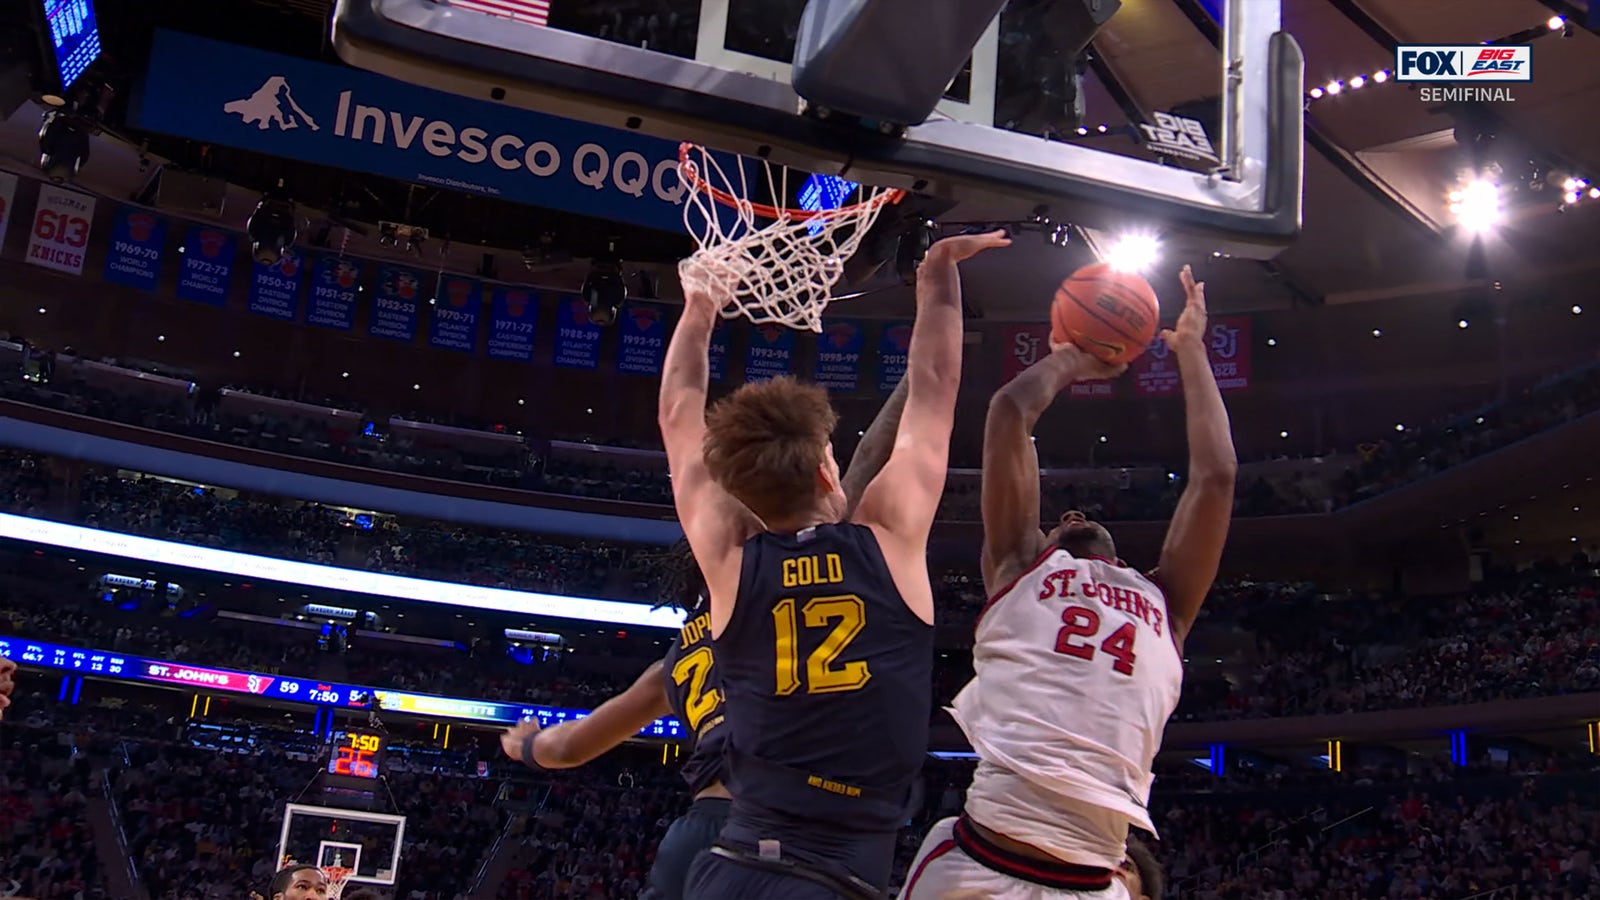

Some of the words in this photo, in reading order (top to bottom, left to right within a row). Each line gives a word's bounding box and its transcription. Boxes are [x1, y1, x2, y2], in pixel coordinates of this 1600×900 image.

[334, 90, 560, 177] Invesco
[573, 143, 690, 206] QQQ
[34, 208, 89, 248] 613
[30, 244, 82, 268] KNICKS
[115, 241, 158, 260] 1969-70
[110, 262, 154, 278] CHAMPIONS
[120, 256, 148, 268] WORLD
[186, 258, 228, 276] 1972-73
[190, 272, 218, 284] WORLD
[257, 274, 296, 291] 1950-51
[182, 280, 224, 294] CHAMPIONS
[316, 286, 354, 302] 1951-52
[377, 298, 416, 313] 1952-53
[437, 308, 474, 324] 1970-71
[495, 319, 534, 334] 1971-72
[782, 554, 844, 588] GOLD
[1039, 569, 1078, 600] ST.
[1081, 576, 1163, 638] JOHN'S
[772, 594, 872, 696] 12
[1054, 606, 1136, 676] 24
[54, 657, 64, 666] 11
[109, 665, 122, 674] 30
[148, 664, 170, 677] ST.
[173, 668, 229, 685] JOHN'S
[280, 681, 299, 694] 59
[309, 688, 339, 702] 7:50
[348, 733, 380, 752] 7:50
[335, 746, 375, 777] 26
